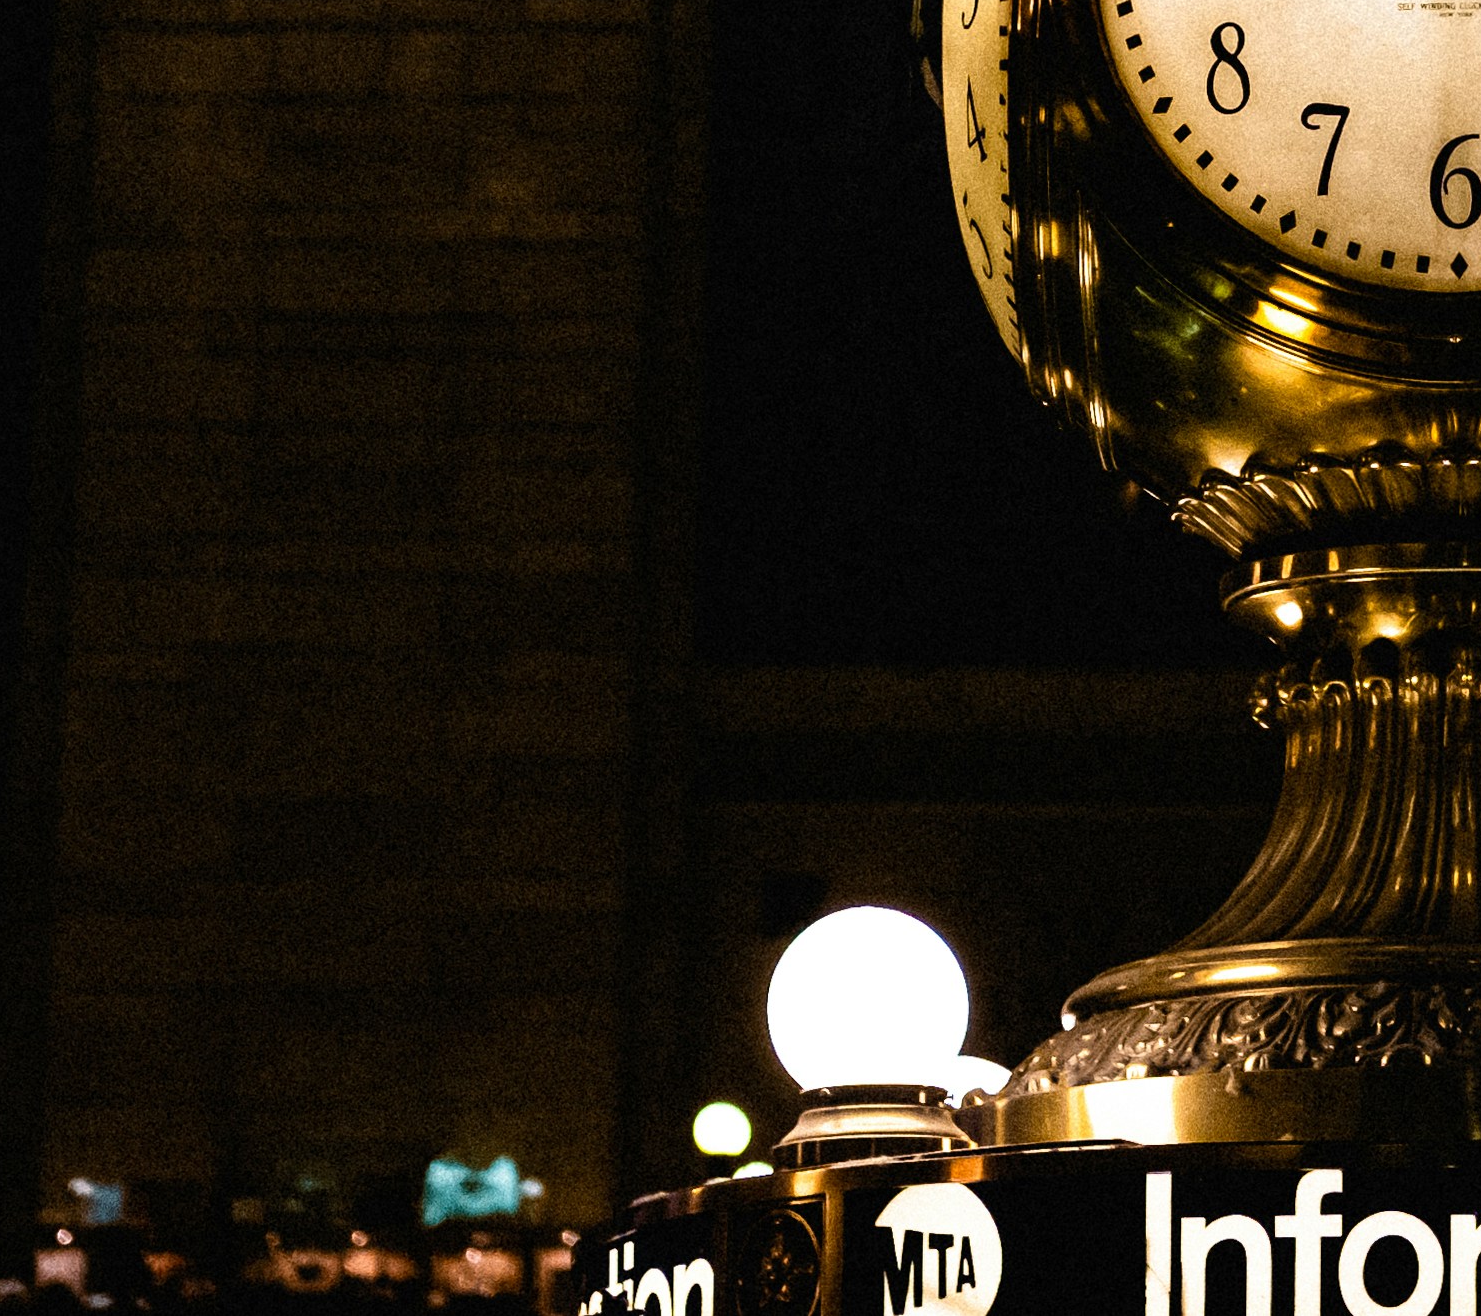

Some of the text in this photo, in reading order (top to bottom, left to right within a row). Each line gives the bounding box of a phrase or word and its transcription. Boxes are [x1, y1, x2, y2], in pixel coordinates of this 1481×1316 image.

[1206, 21, 1251, 116] 8
[966, 74, 989, 165] 4
[1300, 102, 1351, 197] 7
[875, 1226, 976, 1316] MTA
